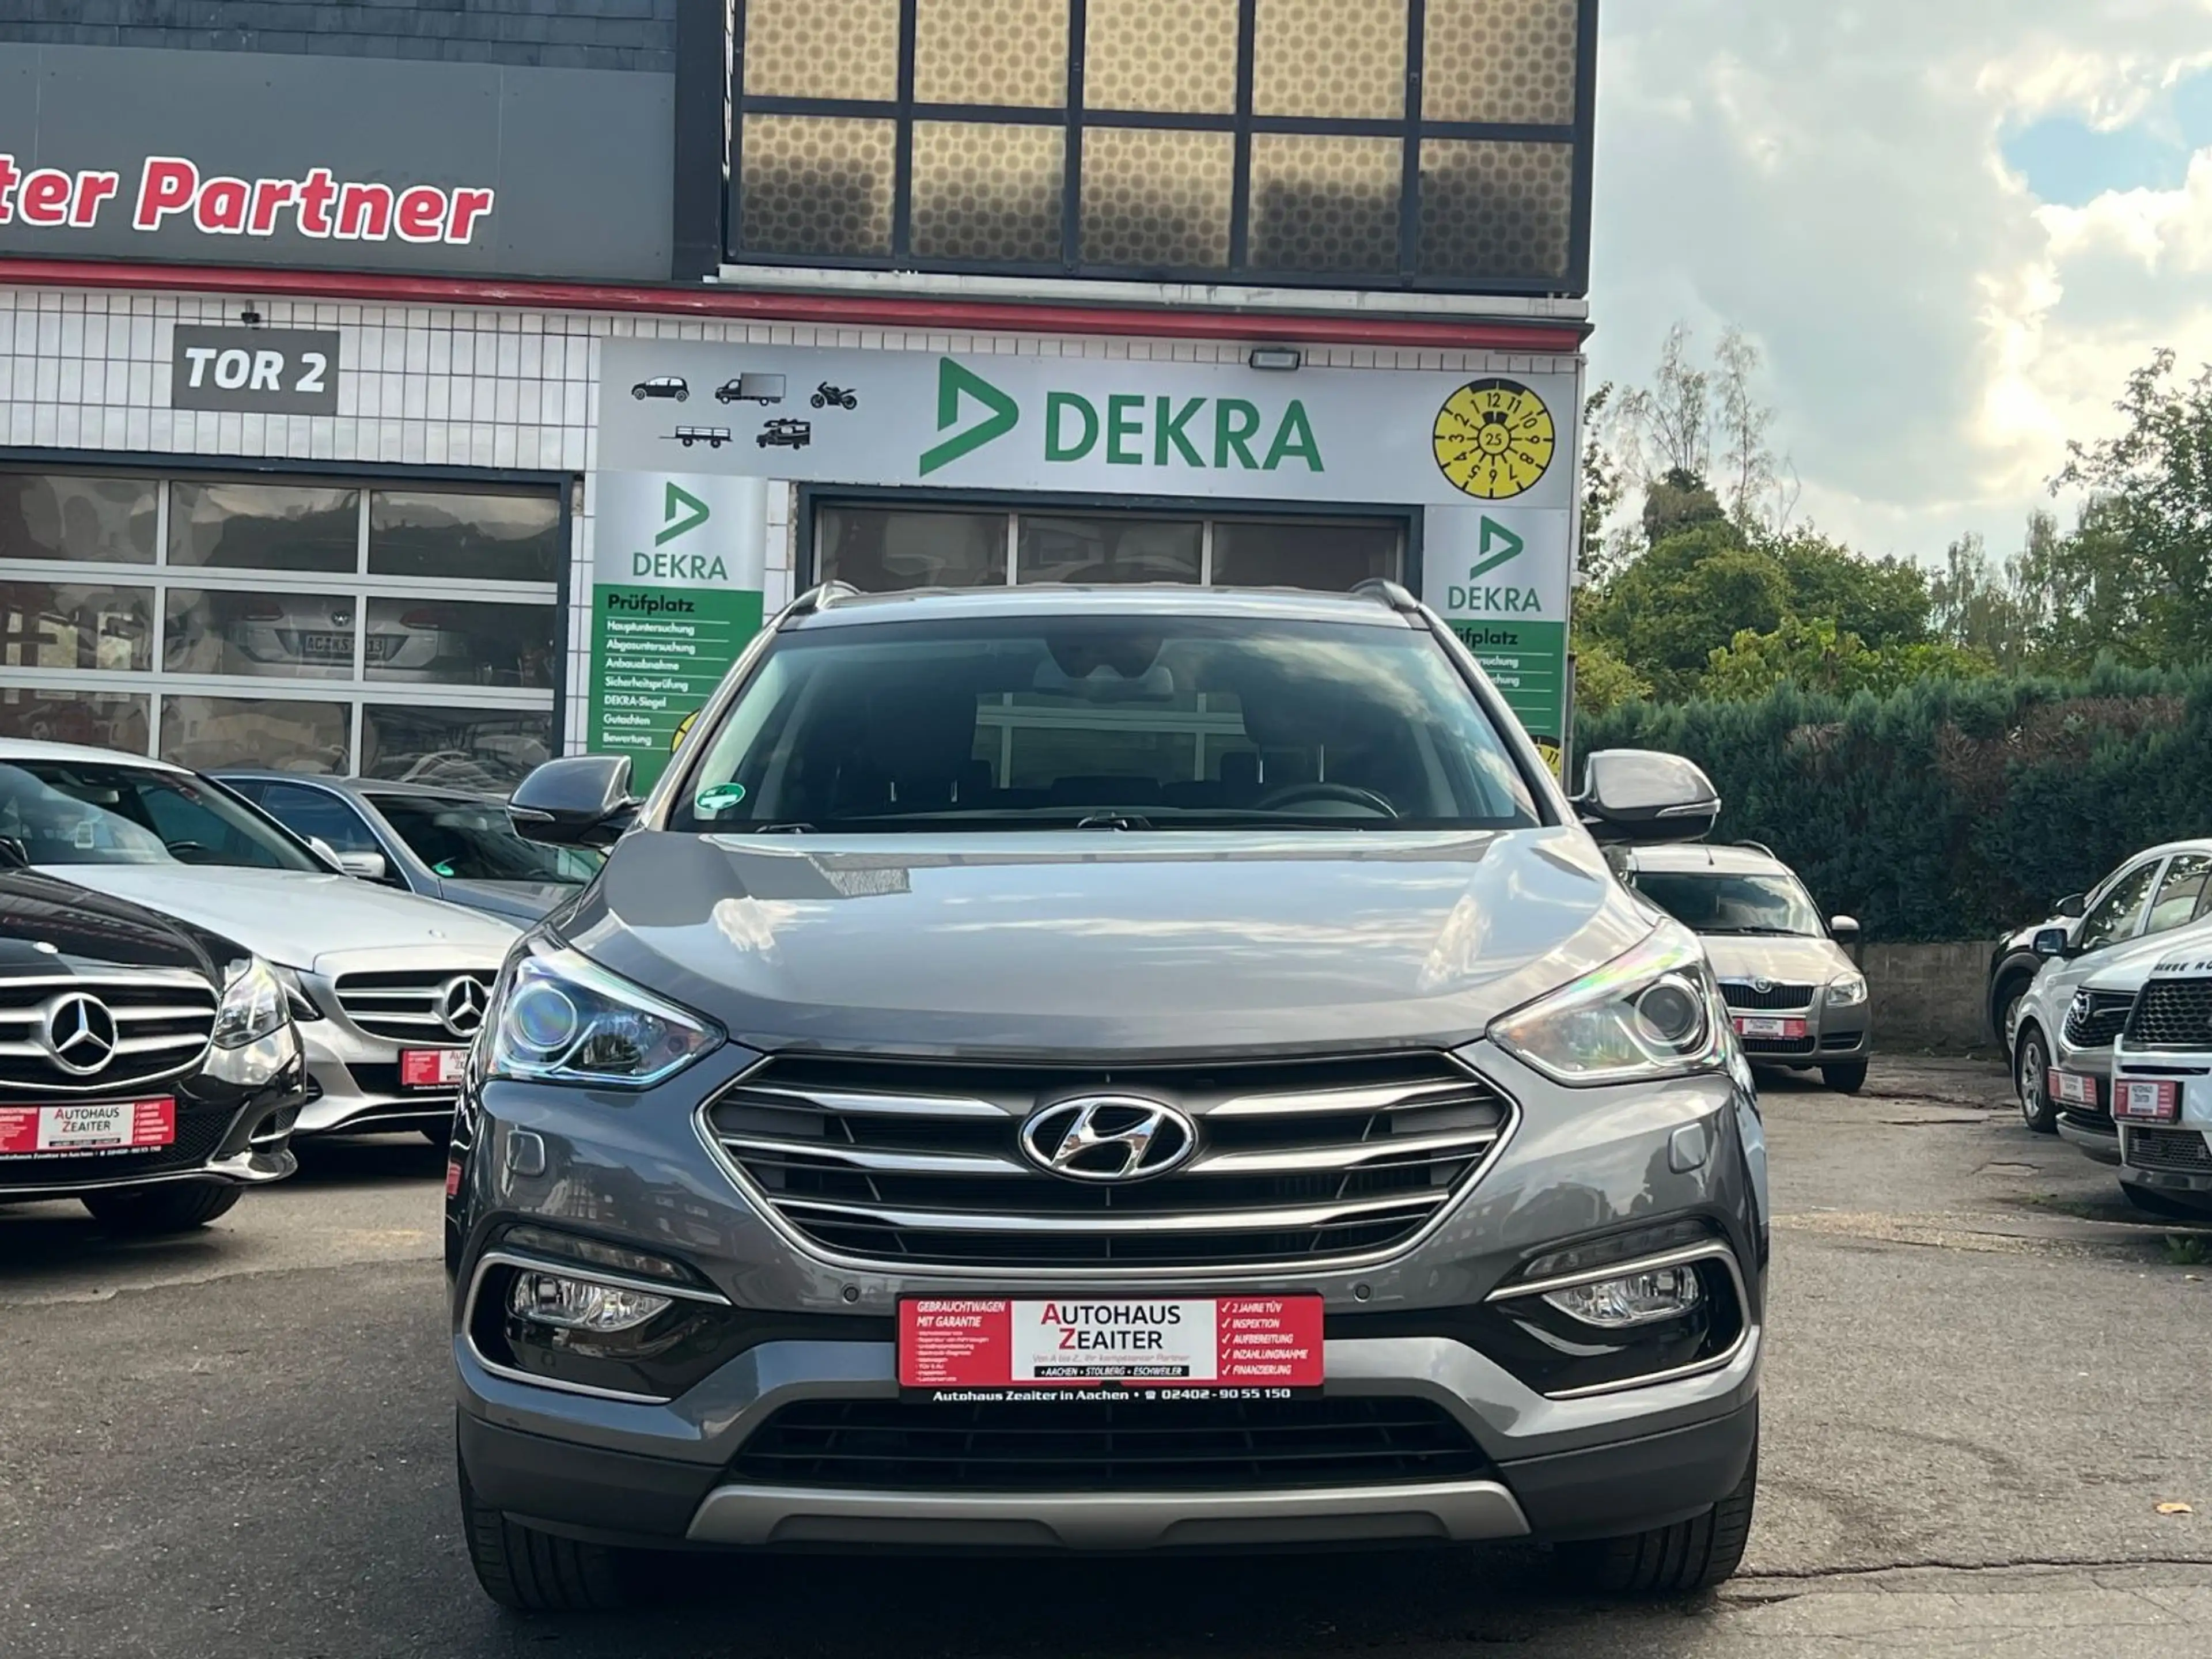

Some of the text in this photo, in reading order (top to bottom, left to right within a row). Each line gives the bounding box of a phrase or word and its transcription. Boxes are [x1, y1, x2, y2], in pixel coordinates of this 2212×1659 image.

[133, 156, 494, 245] Partner
[184, 347, 327, 393] TOR 2
[1487, 393, 1501, 408] 12
[1507, 397, 1522, 414] 11
[1045, 391, 1324, 472] DEKRA
[1486, 433, 1502, 445] 25
[633, 552, 728, 581] DEKRA
[608, 594, 695, 615] Prüfplatz
[1448, 586, 1541, 612] DEKRA
[607, 620, 695, 637] Hauptuntersuchung
[607, 638, 696, 656] Abgasuntersuchung
[605, 657, 679, 671] Anbauabnahme
[605, 676, 688, 692] Sicherheitsprüfung
[604, 695, 666, 710] DEKRA-Siegel
[604, 713, 651, 726] Gutachten
[603, 733, 652, 747] Bewertung
[55, 1107, 119, 1120] AUTOHAUS
[63, 1120, 111, 1132] ZEAITER
[916, 1301, 1006, 1312] GEBRAUCHTWAGEN
[1041, 1303, 1181, 1325] AUTOHAUS
[916, 1316, 982, 1327] MIT GARANTIE
[1232, 1319, 1280, 1328] INSPEKTION
[1059, 1328, 1163, 1349] ZEAITER
[1233, 1334, 1294, 1344] AUFBEREITUNG
[1046, 1366, 1182, 1377] AACHEN STOLBERG ESCHWEILER
[1232, 1365, 1291, 1375] FINANZIERUNG
[933, 1391, 1003, 1402] Autohaus
[1006, 1391, 1058, 1401] Zeaiter
[1060, 1390, 1073, 1400] in
[1075, 1389, 1129, 1400] Aachen
[1161, 1389, 1210, 1400] 02402
[1219, 1388, 1238, 1399] 90
[1241, 1388, 1260, 1399] 55
[1265, 1388, 1291, 1399] 150
